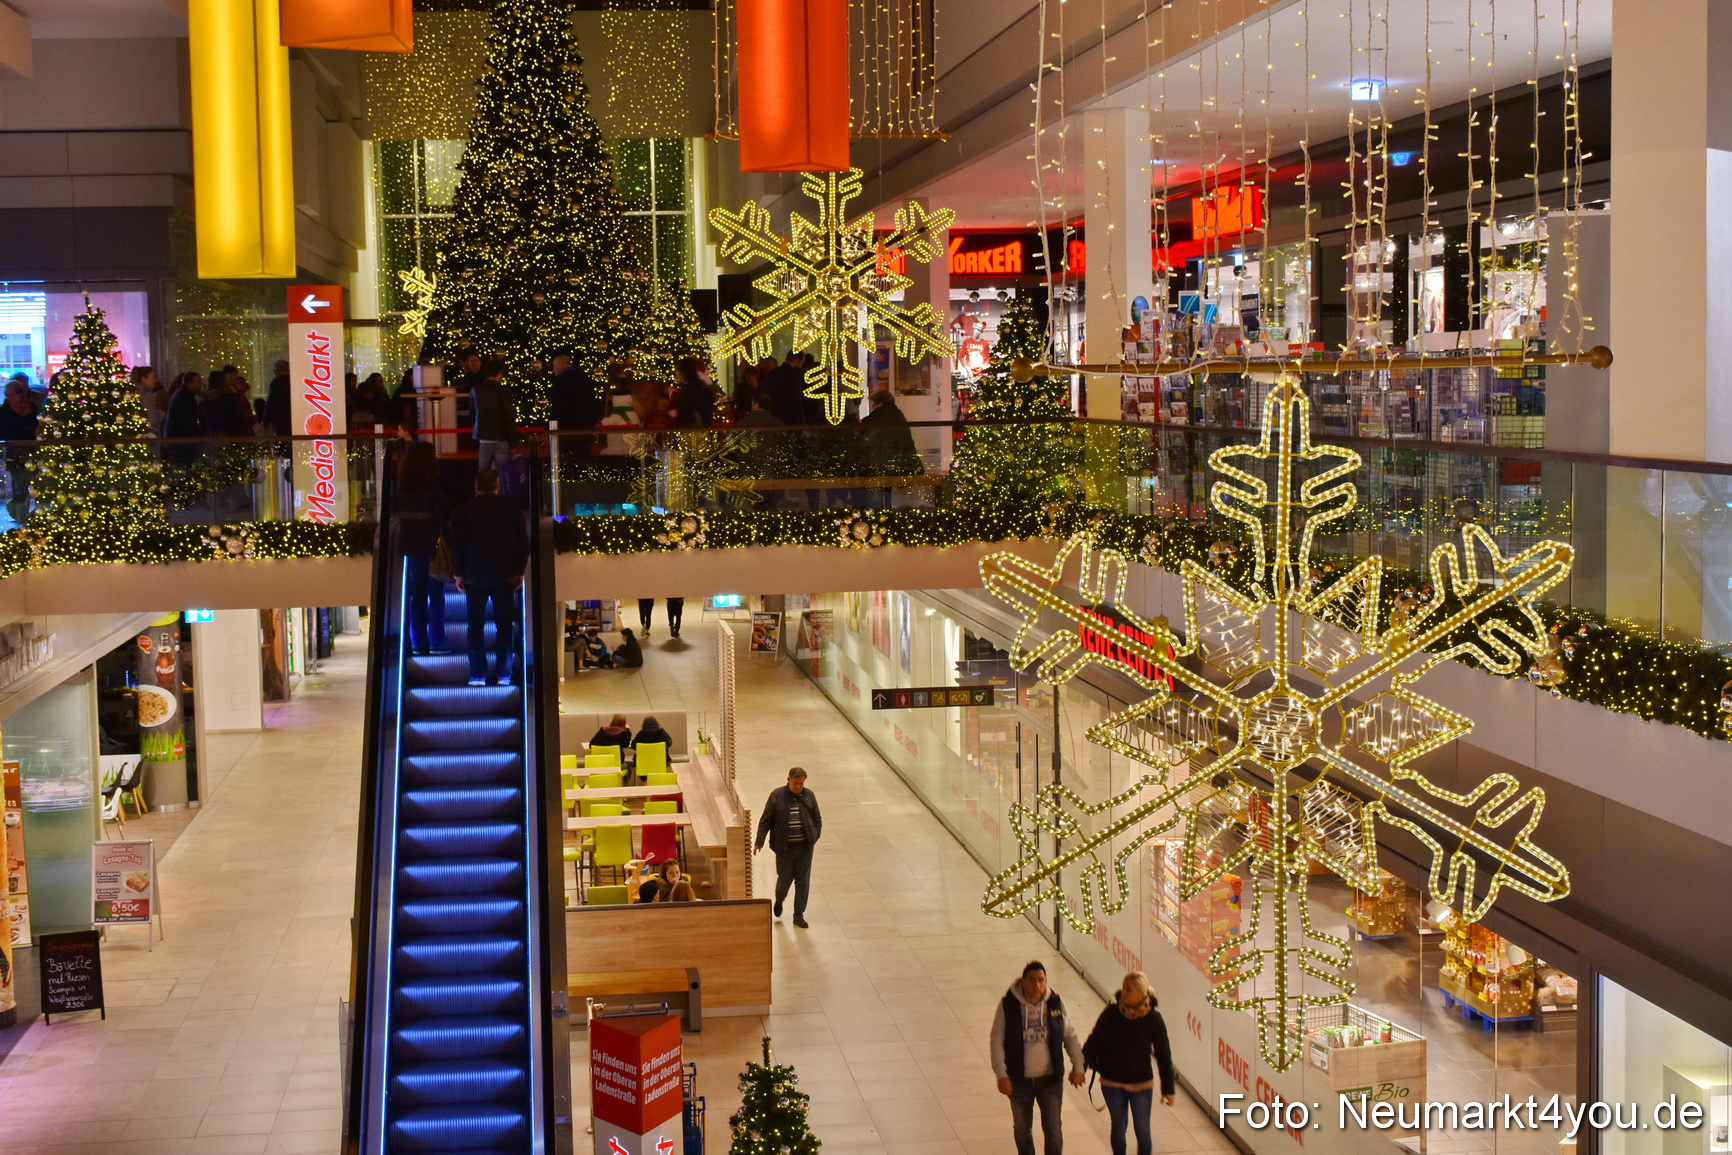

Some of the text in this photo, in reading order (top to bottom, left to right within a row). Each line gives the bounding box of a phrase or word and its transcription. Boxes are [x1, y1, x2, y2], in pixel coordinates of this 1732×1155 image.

[103, 854, 142, 865] Lasagne-Tag
[592, 1049, 637, 1076] Sie finden uns
[642, 1045, 680, 1076] Sie finden uns
[1218, 1036, 1249, 1093] REWE
[593, 1064, 637, 1091] in der Oberen
[643, 1061, 680, 1091] in der Oberen
[595, 1080, 636, 1105] Ladenstraße
[644, 1076, 680, 1105] Ladenstraße
[1373, 1082, 1410, 1102] Bio
